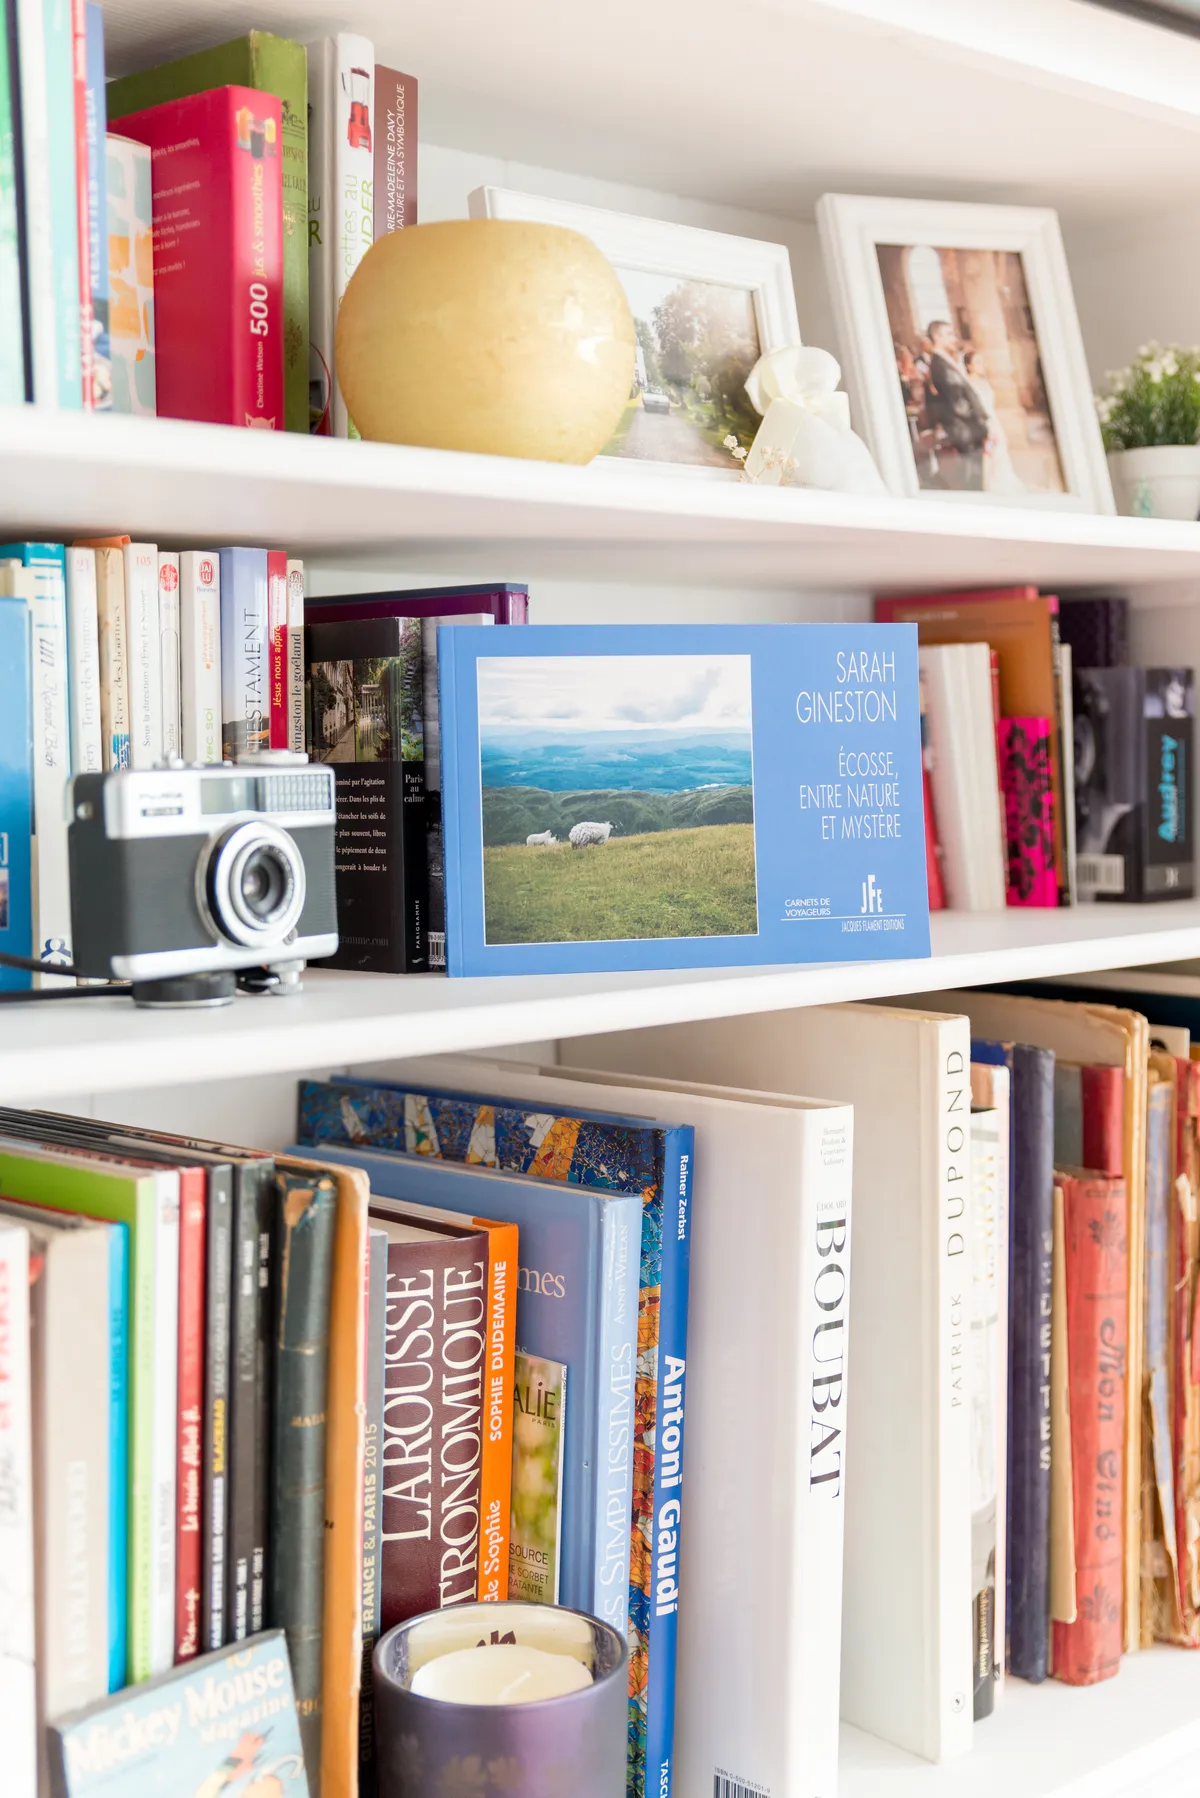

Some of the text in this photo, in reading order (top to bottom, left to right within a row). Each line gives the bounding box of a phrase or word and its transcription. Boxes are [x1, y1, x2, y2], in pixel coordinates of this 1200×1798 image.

[396, 83, 406, 158] SYMBOLIQUE
[386, 109, 397, 234] RIE-MADELEINE DAVY
[396, 161, 405, 176] SA
[396, 177, 405, 190] ET
[250, 163, 269, 336] 500 jus & smoothies
[256, 341, 264, 408] Christine Watson
[136, 555, 152, 567] 105
[273, 626, 284, 653] appre
[244, 608, 263, 749] TESTAMENT
[273, 655, 282, 680] nous
[836, 651, 896, 683] SARAH
[141, 671, 151, 712] direction
[272, 682, 282, 708] Jésus
[291, 633, 304, 754] ivingston le goéland
[796, 690, 898, 723] GINESTON
[142, 714, 151, 723] la
[143, 728, 152, 747] Sous
[202, 707, 214, 769] vec soi
[404, 774, 424, 784] Paris
[838, 745, 899, 780] ÉCOSSE,
[336, 778, 351, 786] ominé
[361, 778, 386, 787] l'agitation
[403, 794, 425, 803] calme
[800, 782, 900, 809] ENTRE NATURE
[1157, 734, 1178, 843] Audrey
[370, 796, 379, 805] plis
[380, 812, 386, 820] de
[339, 829, 387, 838] plus souvent, libres
[821, 807, 902, 840] ET MYSTÈRE
[334, 864, 356, 872] ongerait
[784, 897, 831, 907] CARNETS DE
[784, 907, 832, 917] VOYAGEURS
[841, 920, 862, 932] JACQUES
[862, 920, 882, 931] FLAMENT
[679, 1154, 689, 1196] Rainer
[677, 1199, 687, 1241] Zerbst
[946, 1050, 965, 1408] PATRICK DUPOND
[615, 1225, 629, 1282] WILLAN
[517, 1266, 566, 1299] mes
[491, 1260, 508, 1371] DUDEMAINE
[613, 1286, 627, 1325] ANNE
[809, 1211, 847, 1500] BOUBAT
[382, 1269, 435, 1541] LAROUSSE
[489, 1375, 504, 1443] SOPHIE
[660, 1354, 687, 1489] Antoni
[438, 1260, 487, 1609] TRONOMIQUE
[531, 1418, 556, 1429] PARIS
[364, 1423, 378, 1468] 2015
[600, 1342, 632, 1586] SIMPLISSIMES
[364, 1473, 378, 1531] PARIS
[363, 1536, 377, 1550] &
[483, 1499, 505, 1576] Sophie
[509, 1542, 548, 1565] SOURCE
[508, 1577, 544, 1597] RATANTE
[517, 1566, 549, 1585] SORBET
[362, 1556, 376, 1633] FRANCE
[61, 1656, 286, 1783] Mickey Mouse
[714, 1766, 771, 1793] ISBN 0-500-51201-9
